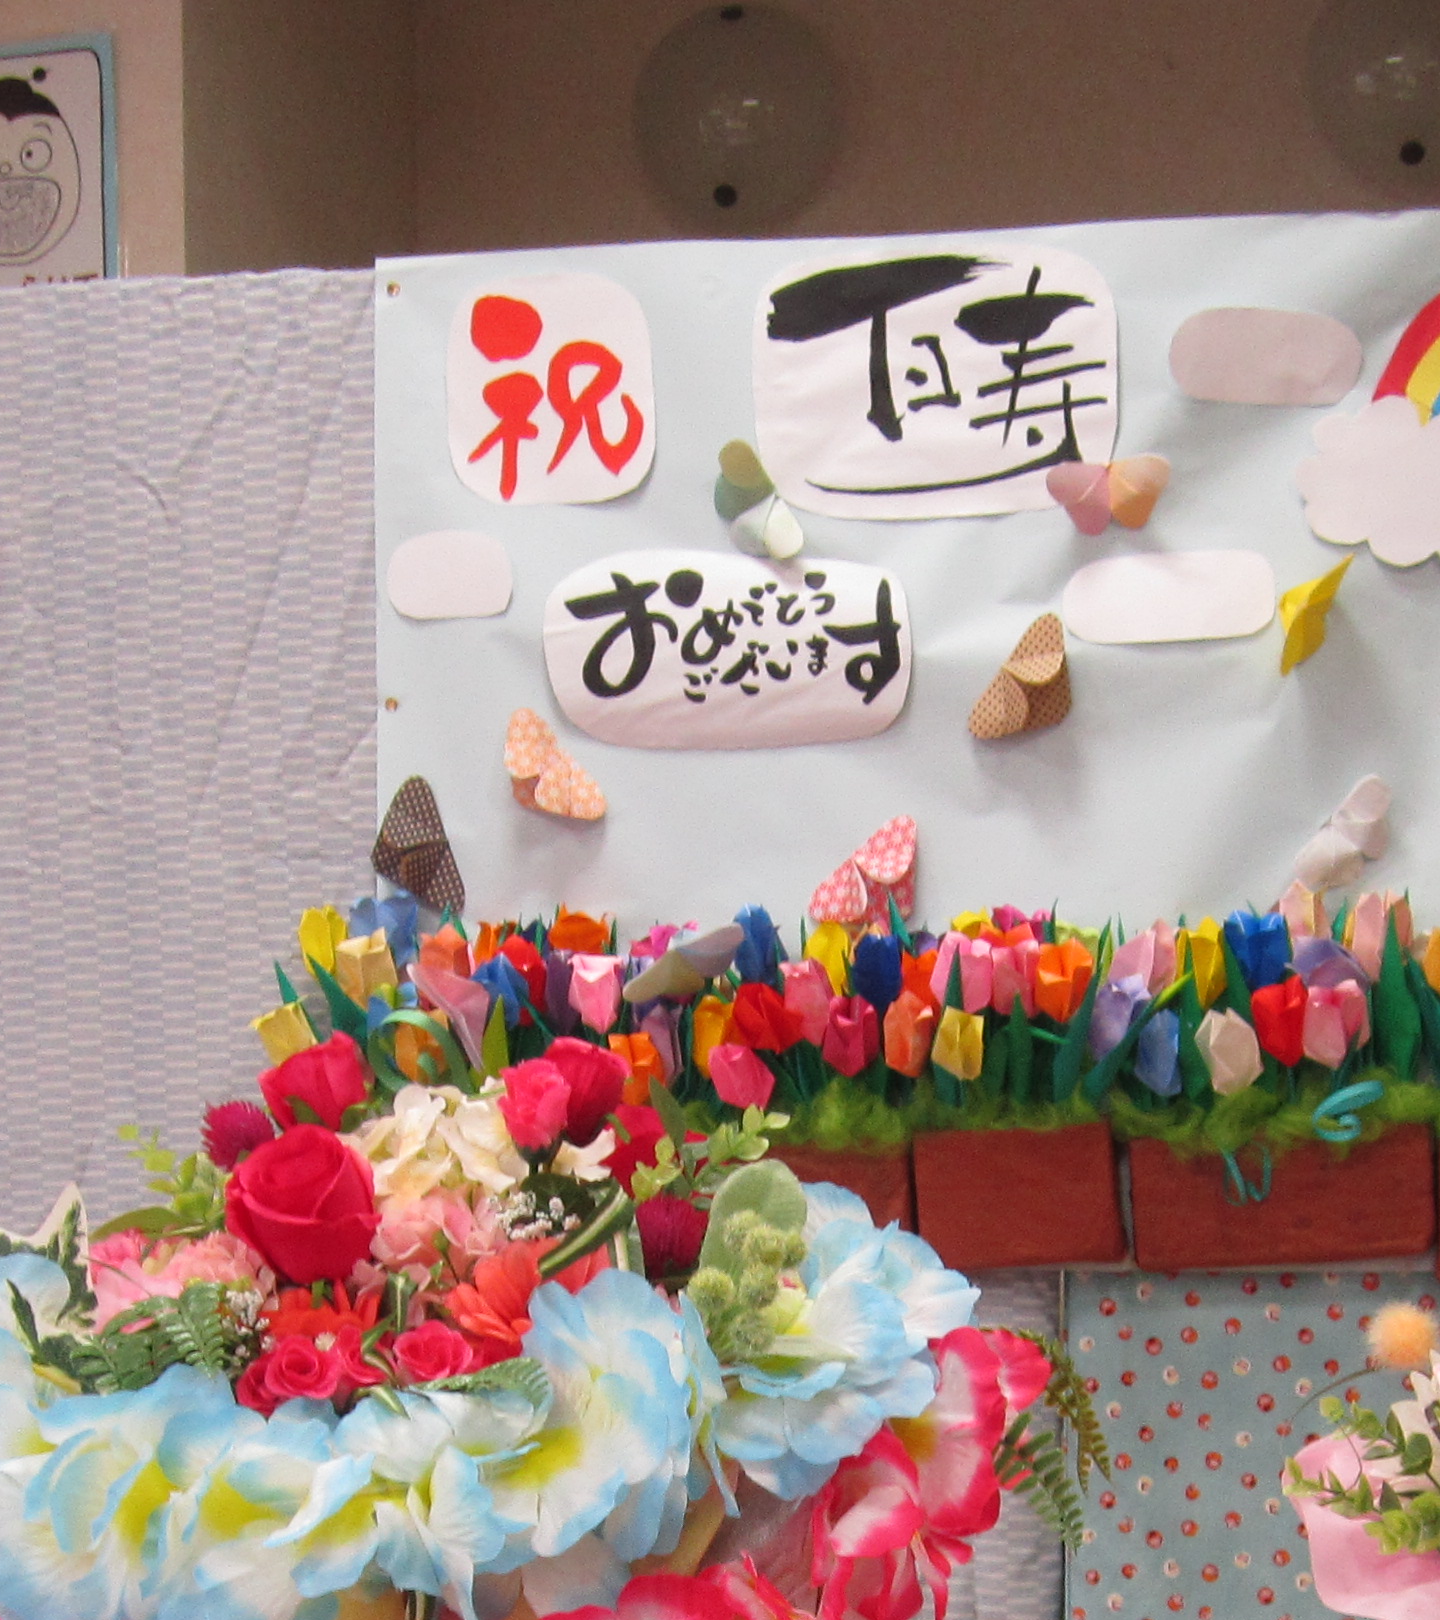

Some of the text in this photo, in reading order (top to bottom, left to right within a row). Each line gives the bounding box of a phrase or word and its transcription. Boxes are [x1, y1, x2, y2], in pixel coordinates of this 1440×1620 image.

[468, 294, 644, 501] 祝
[564, 568, 836, 698] おめでとう
